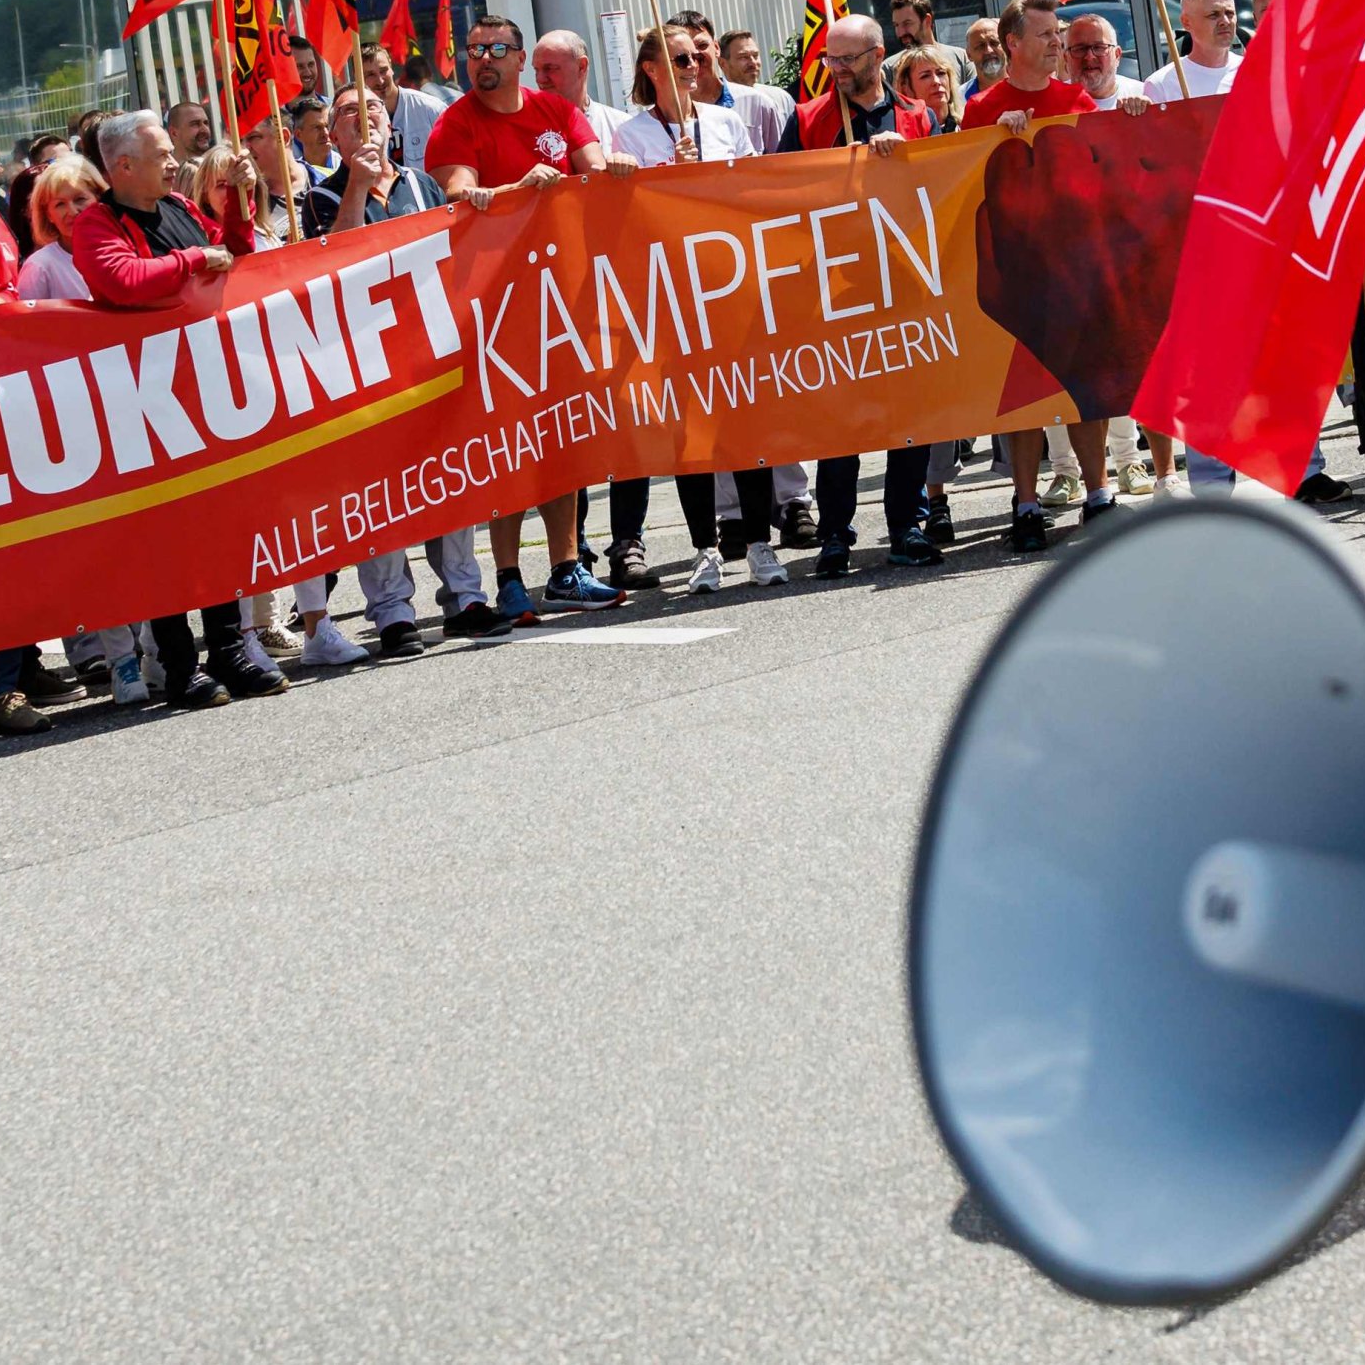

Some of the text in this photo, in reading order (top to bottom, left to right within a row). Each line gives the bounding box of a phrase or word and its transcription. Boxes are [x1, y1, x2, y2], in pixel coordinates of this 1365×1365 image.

[470, 186, 944, 413] KÄMPFEN
[251, 312, 960, 585] ALLE BELEGSCHAFTEN IM VW-KONZERN
